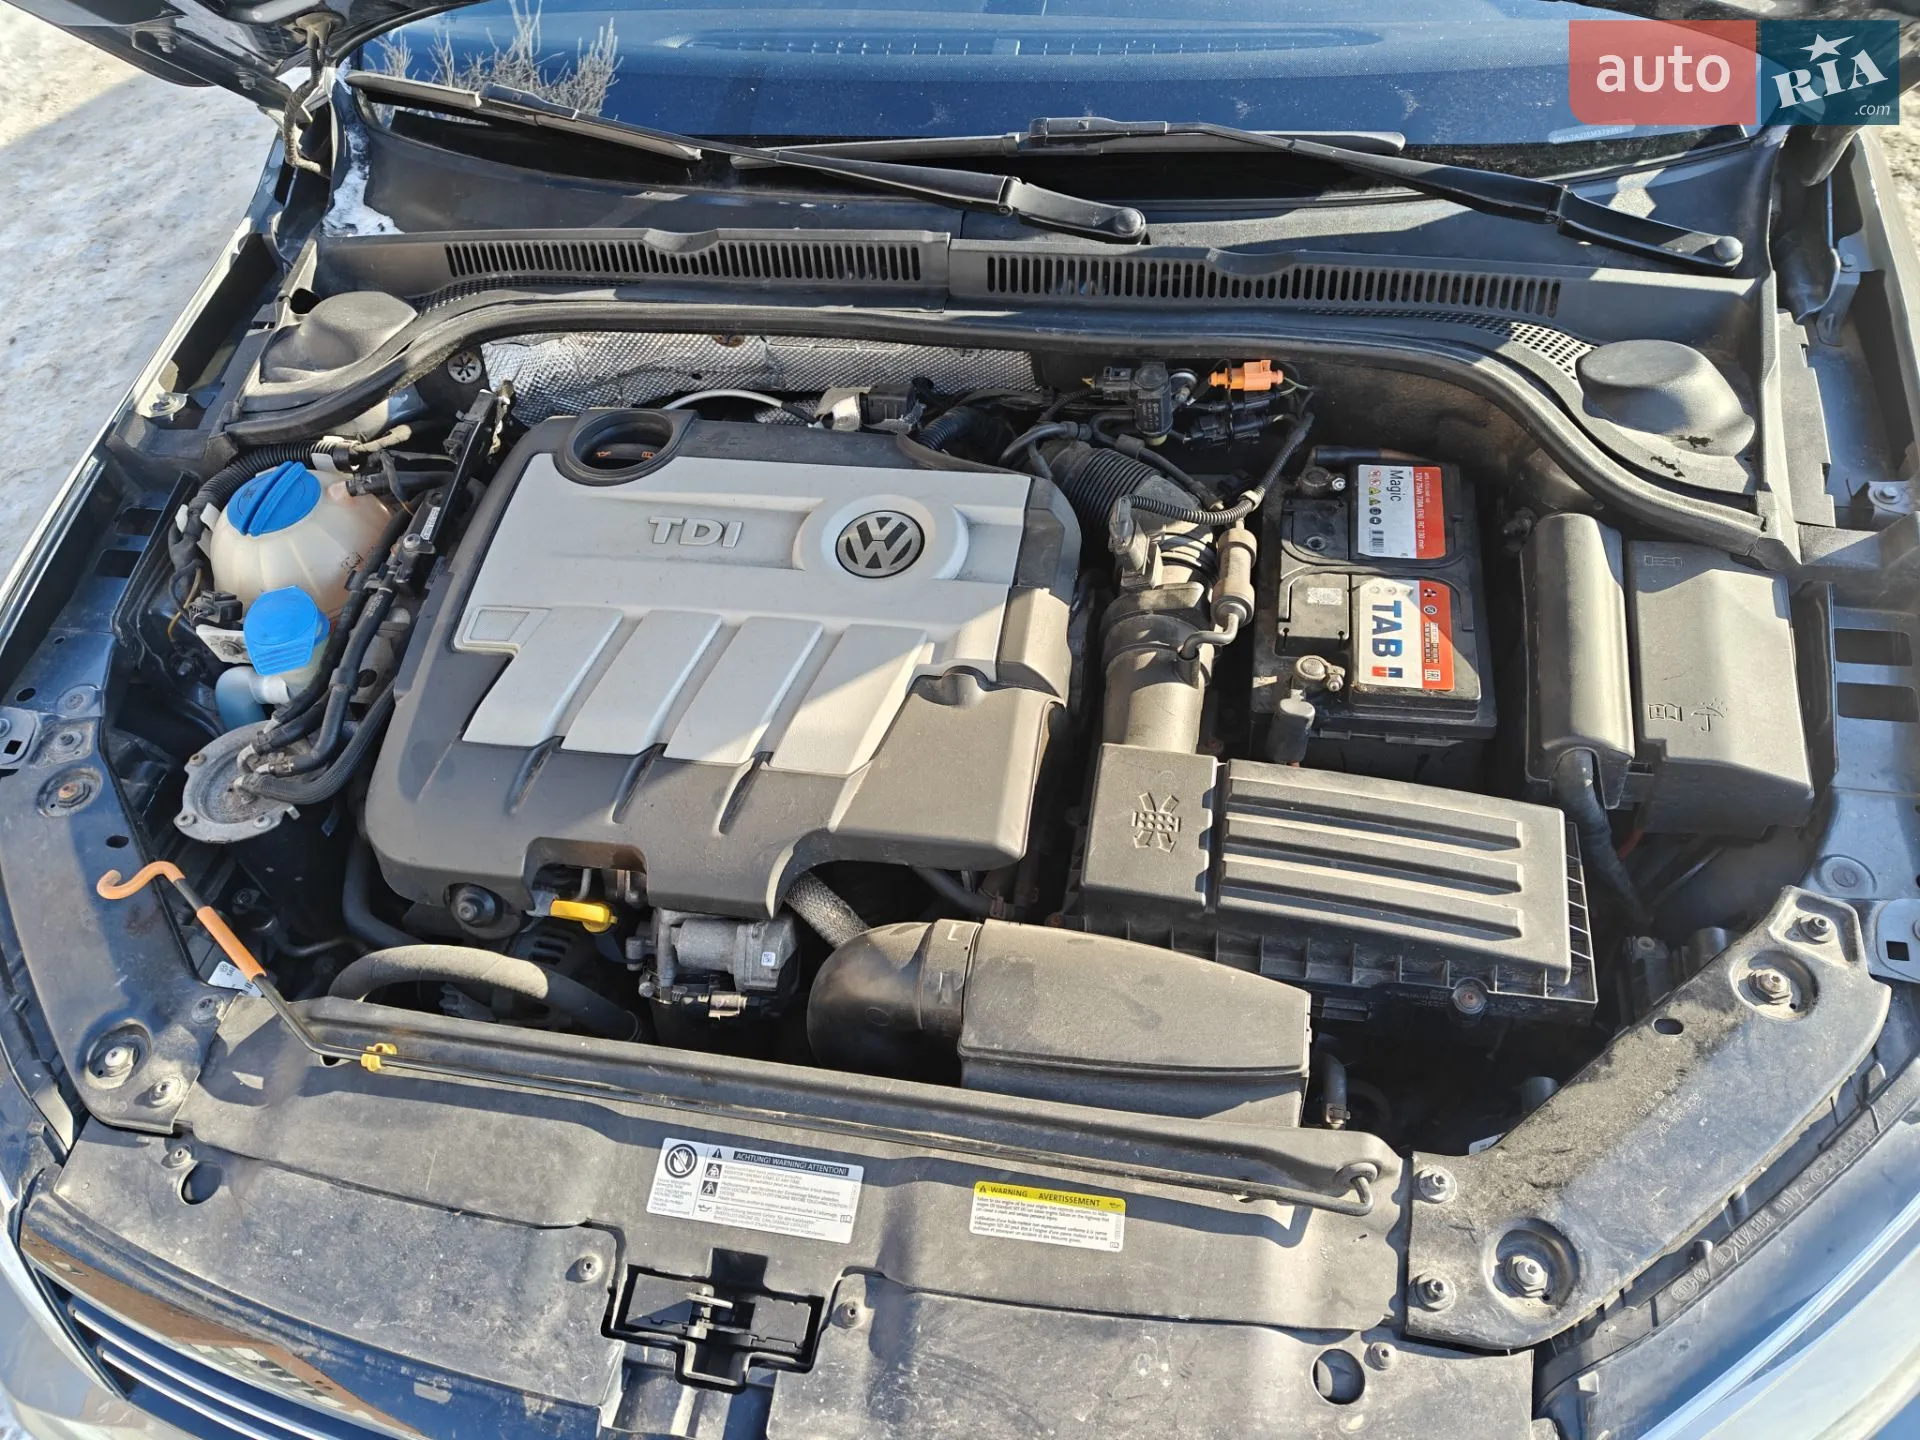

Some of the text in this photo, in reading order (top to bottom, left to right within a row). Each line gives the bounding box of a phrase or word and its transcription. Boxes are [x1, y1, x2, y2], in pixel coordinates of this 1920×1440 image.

[1386, 470, 1405, 502] Magic
[648, 516, 744, 549] TDI
[1371, 600, 1403, 657] TAB
[735, 1152, 848, 1175] ACHTUNG! WARNING! ATTENTION!
[990, 1186, 1101, 1206] WARNING AVERTISSEMENT
